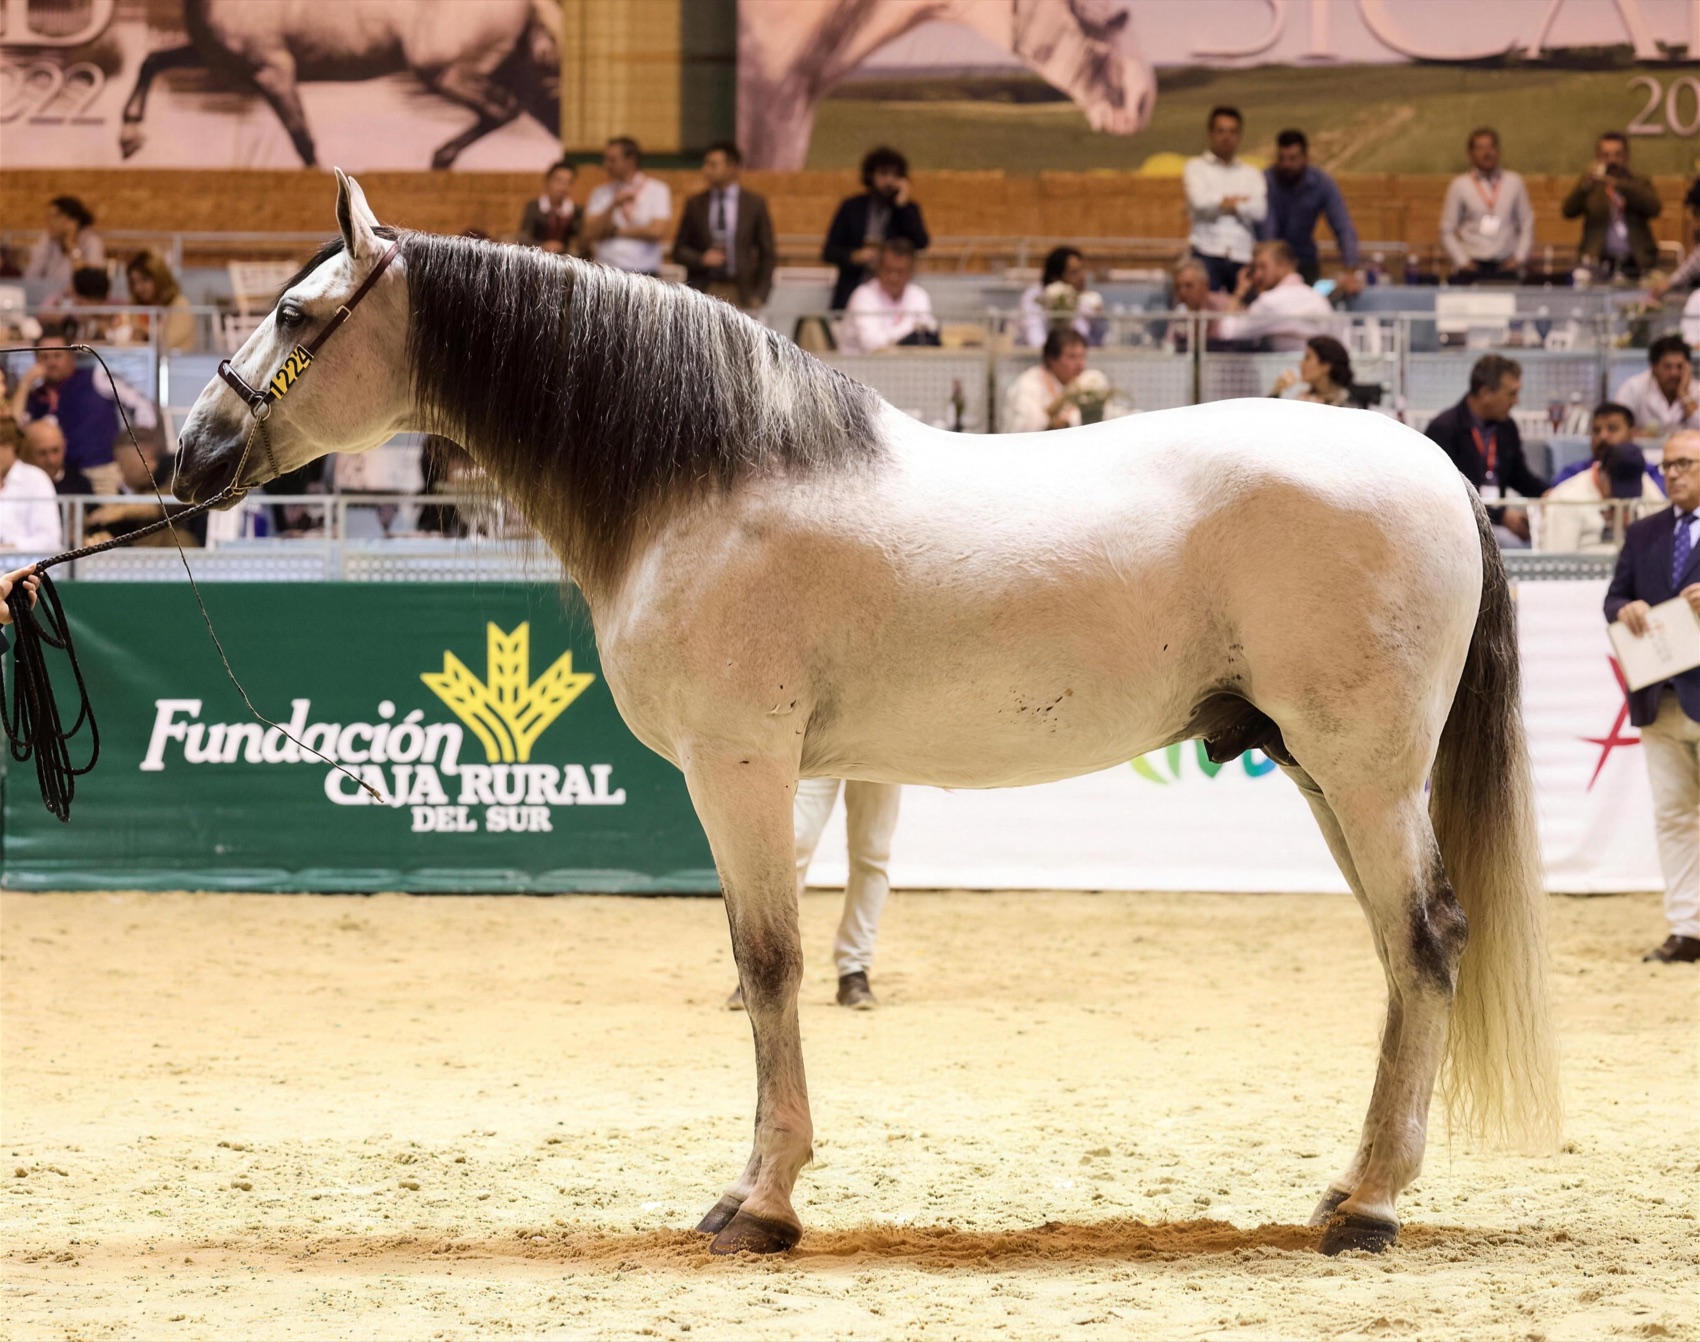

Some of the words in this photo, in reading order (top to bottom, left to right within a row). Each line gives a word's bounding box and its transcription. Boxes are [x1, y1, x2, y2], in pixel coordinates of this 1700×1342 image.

[269, 345, 313, 399] 1224
[139, 698, 463, 776] Fundación
[323, 764, 450, 809] CAJA
[457, 764, 627, 805] RURAL
[411, 805, 478, 832] DEL
[485, 805, 553, 832] SUR
